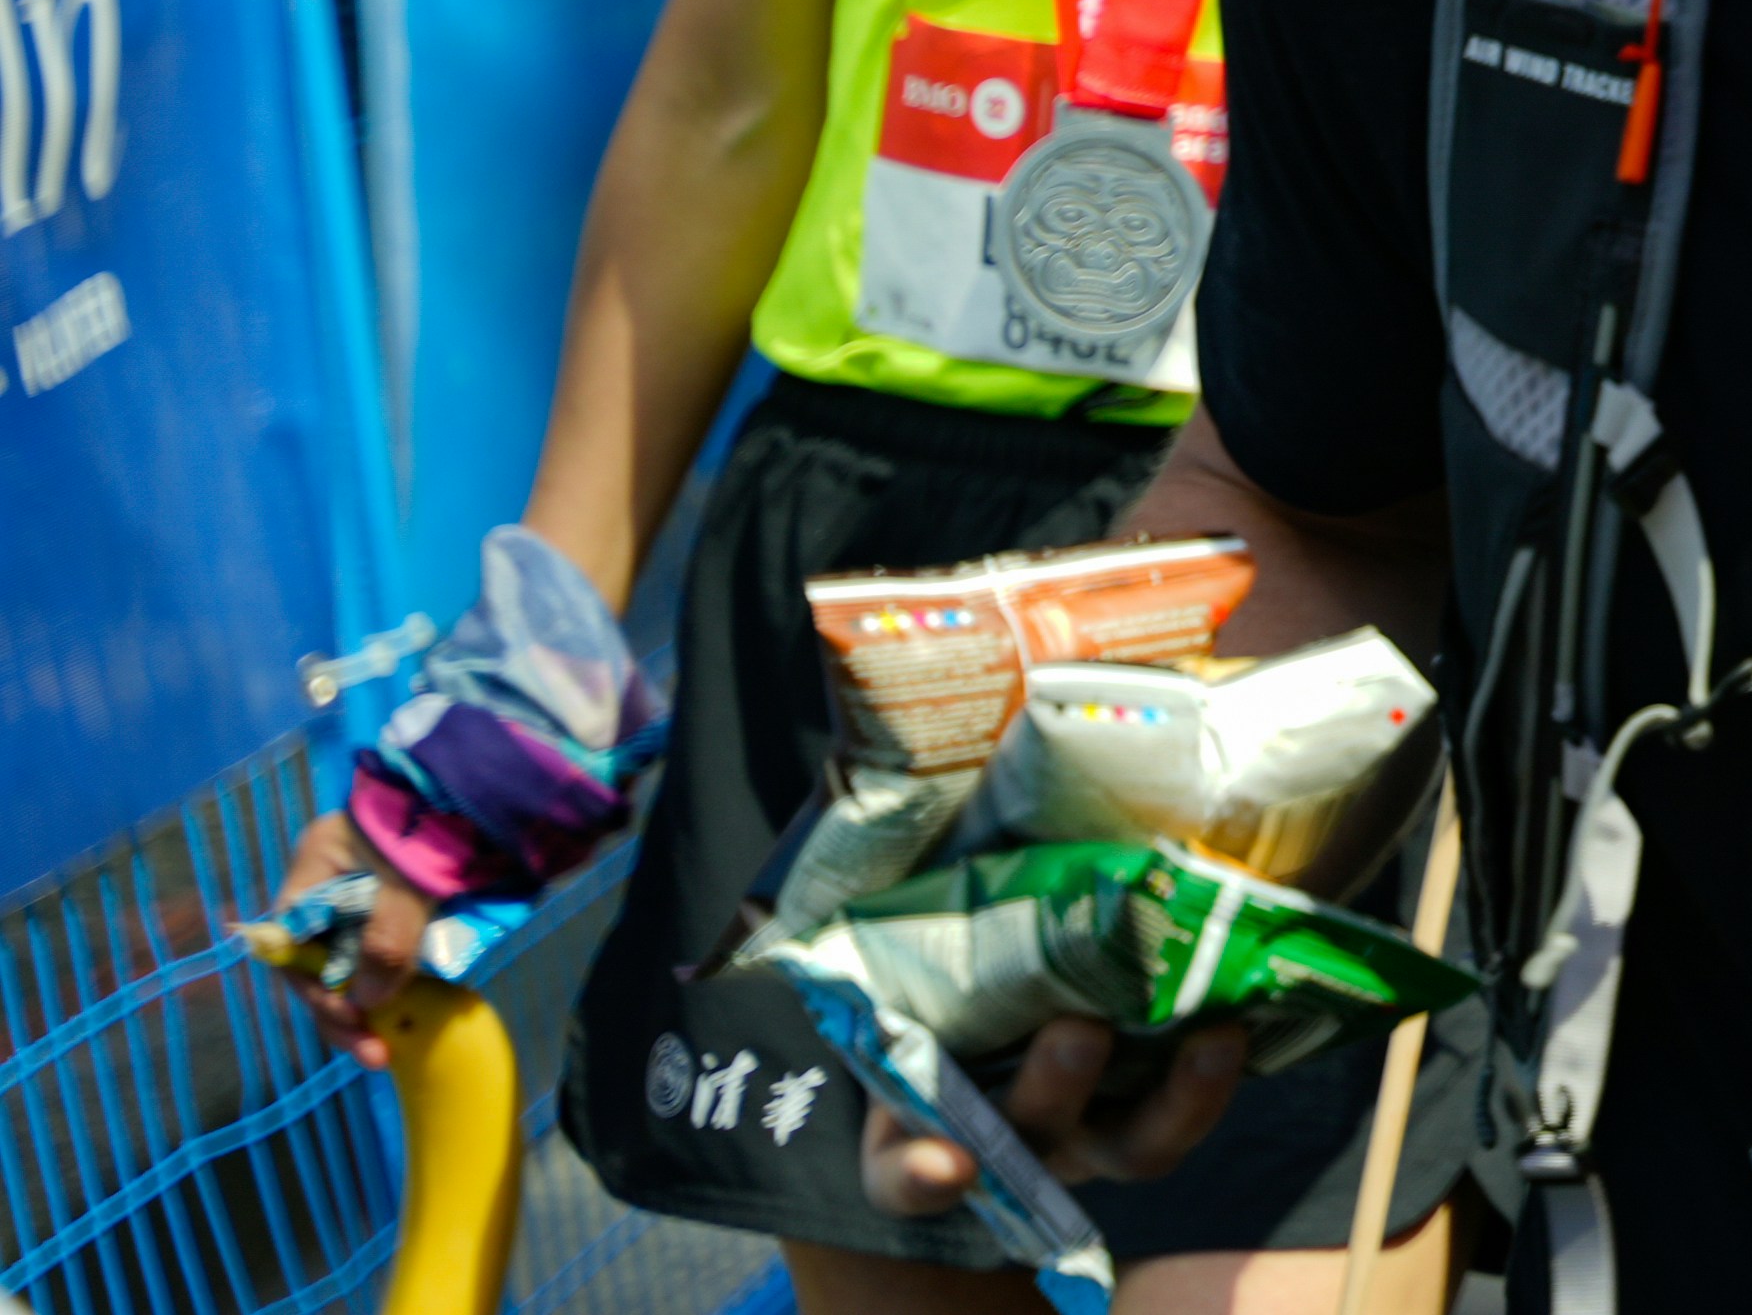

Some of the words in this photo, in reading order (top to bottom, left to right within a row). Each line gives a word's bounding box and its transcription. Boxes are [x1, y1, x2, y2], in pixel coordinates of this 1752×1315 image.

[1463, 34, 1503, 68] AIR
[1503, 44, 1561, 88] WIND
[1560, 61, 1637, 107] TRACKE
